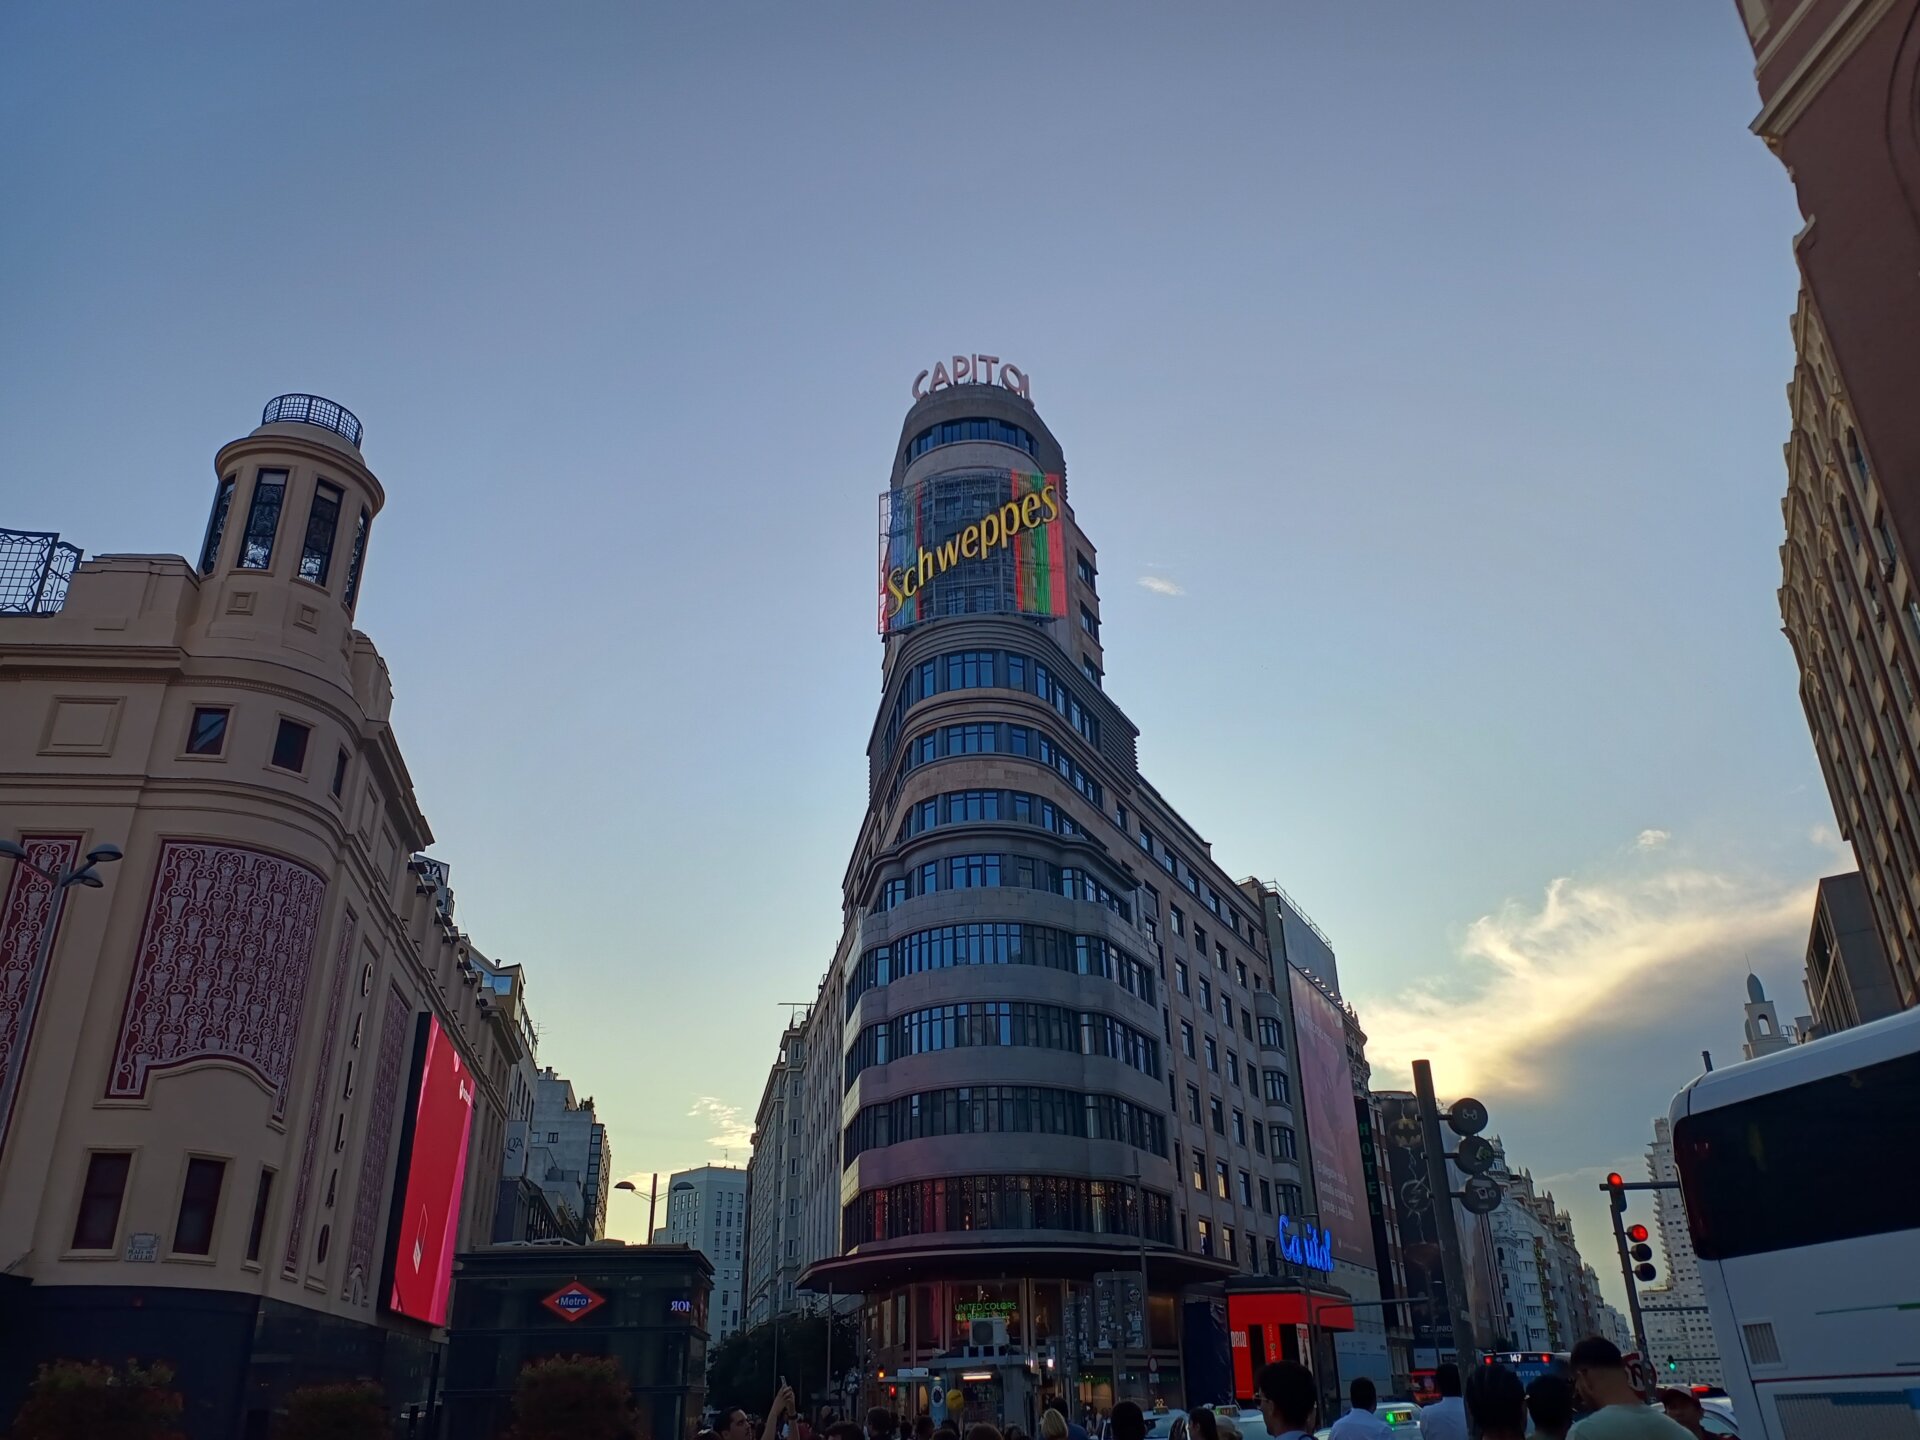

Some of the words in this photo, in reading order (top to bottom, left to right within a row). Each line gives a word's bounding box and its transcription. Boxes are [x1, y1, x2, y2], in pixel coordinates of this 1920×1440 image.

[886, 483, 1059, 618] Schweppes
[317, 961, 374, 1264] CALLAO
[1358, 1120, 1381, 1216] HOTEL
[1278, 1214, 1335, 1273] Caitol
[560, 1296, 588, 1307] Metro
[954, 1303, 983, 1312] UNITED
[984, 1302, 1017, 1311] COLORS
[1510, 1354, 1522, 1363] 147
